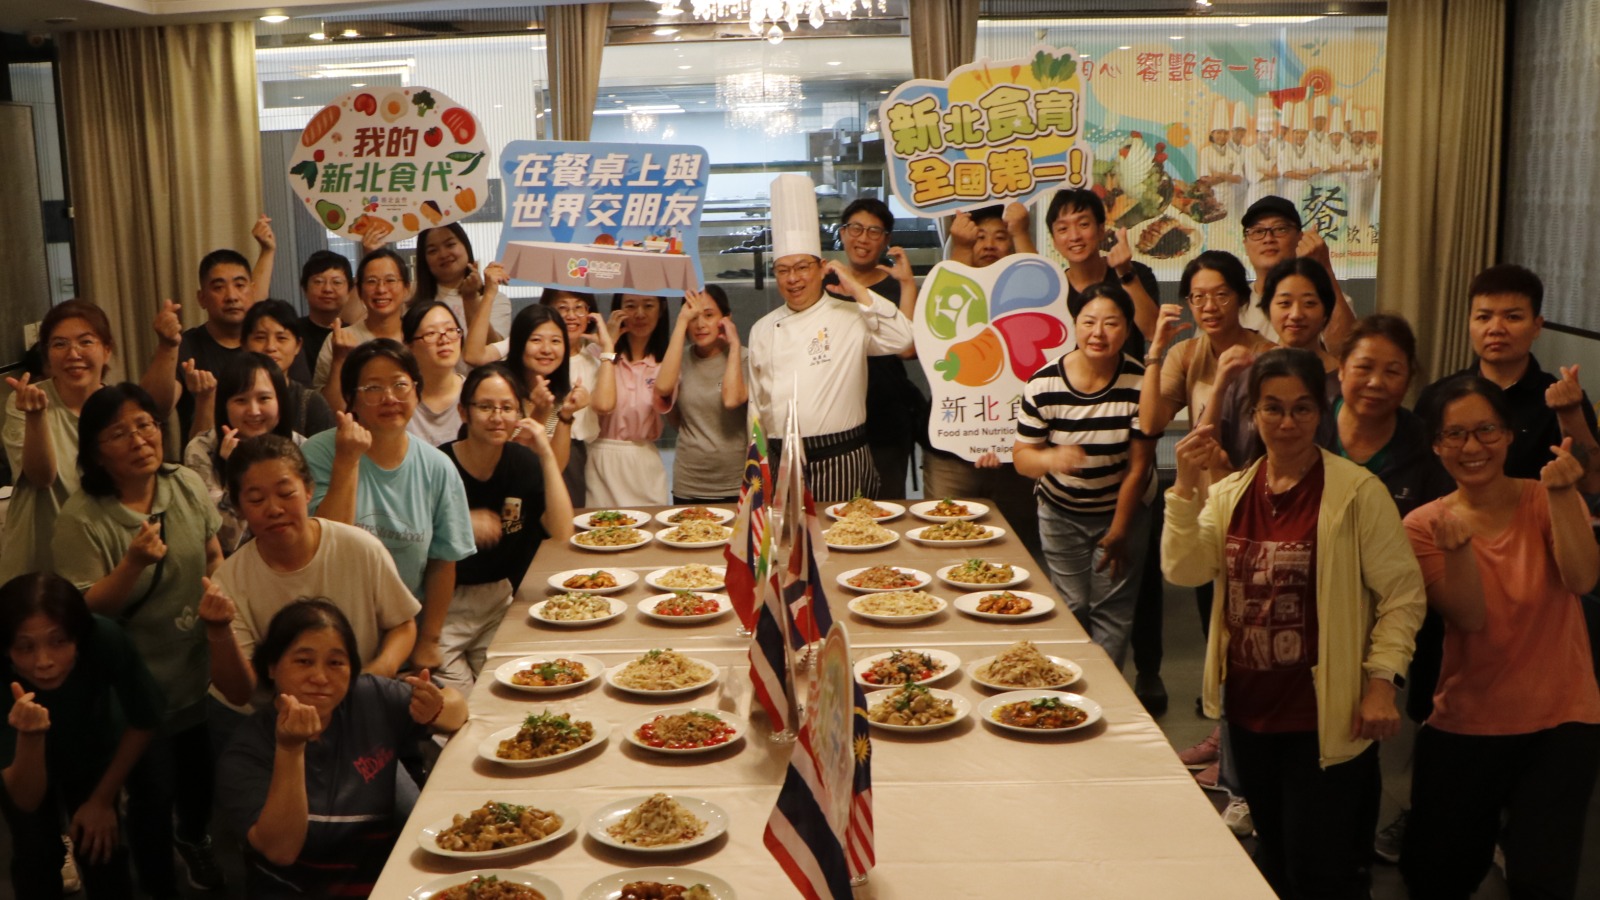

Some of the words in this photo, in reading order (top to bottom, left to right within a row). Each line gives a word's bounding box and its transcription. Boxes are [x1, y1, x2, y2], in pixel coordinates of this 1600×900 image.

[886, 85, 1076, 156] 新北食育
[353, 126, 419, 158] 我的
[319, 161, 453, 194] 新北食代
[513, 152, 703, 189] 在餐桌上與
[511, 193, 700, 229] 世界交朋友
[937, 428, 960, 437] Food
[962, 428, 979, 437] and
[982, 427, 1016, 436] Nutritio
[969, 446, 989, 454] New
